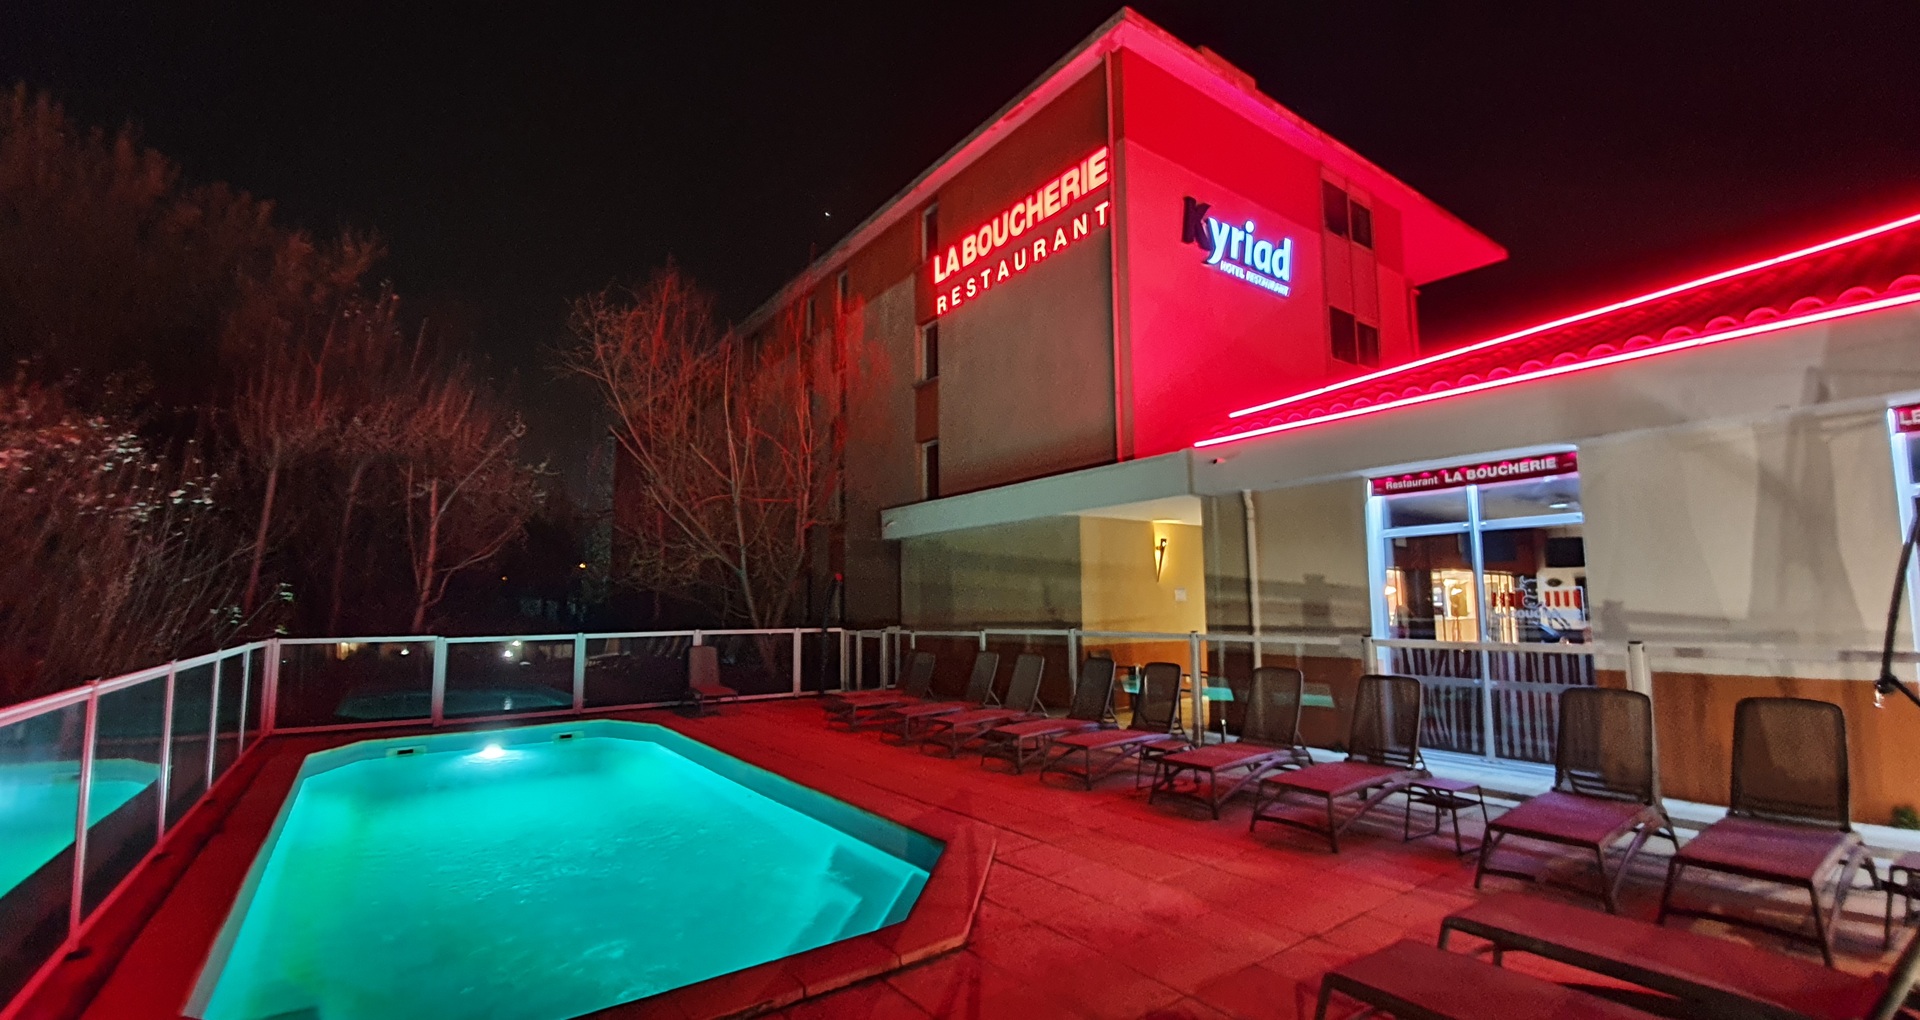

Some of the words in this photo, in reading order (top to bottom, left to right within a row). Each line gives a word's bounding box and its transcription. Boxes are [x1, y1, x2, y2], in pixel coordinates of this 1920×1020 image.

[934, 245, 961, 284] LA
[962, 146, 1108, 267] BOUCHERIE
[936, 201, 1109, 315] RESTAURANT
[1182, 196, 1292, 282] Kyriad
[1385, 475, 1440, 490] Restaurant
[1443, 469, 1463, 483] LA
[1466, 457, 1557, 480] BOUCHERIE
